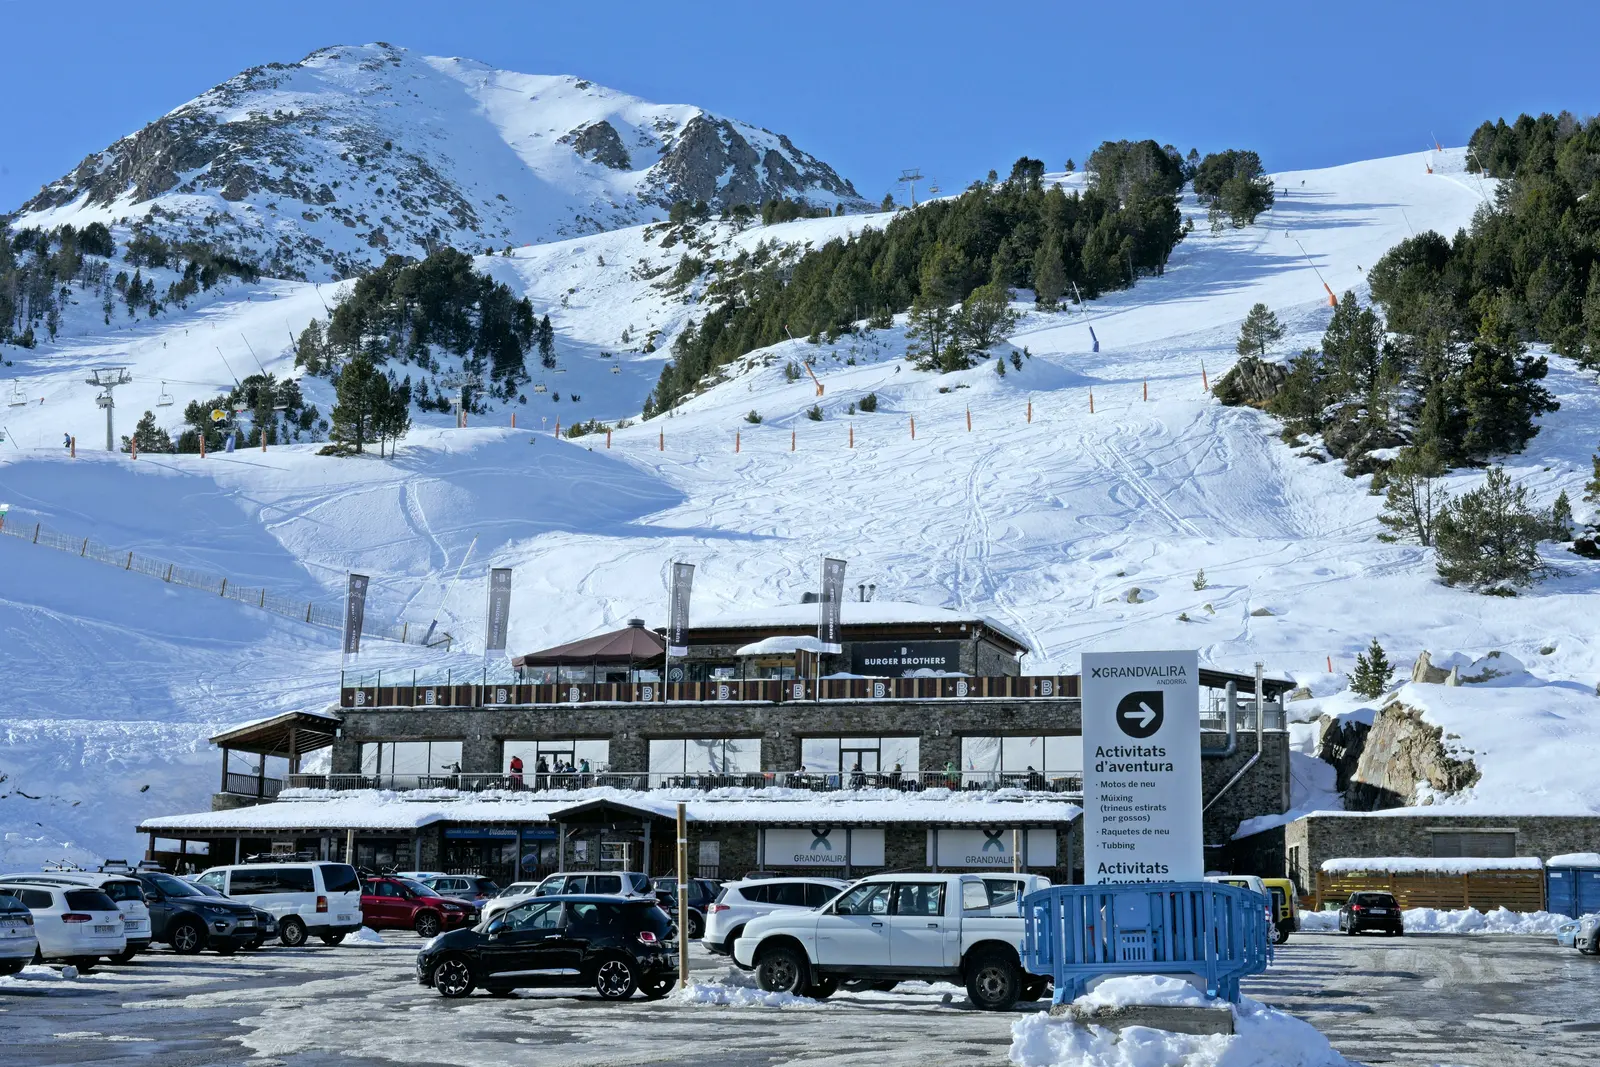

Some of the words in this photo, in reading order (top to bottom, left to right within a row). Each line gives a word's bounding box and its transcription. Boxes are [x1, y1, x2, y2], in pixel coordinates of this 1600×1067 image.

[901, 657, 946, 665] BROTHERS
[1095, 745, 1166, 758] Activitats
[1095, 761, 1173, 772] d'aventura
[1100, 794, 1133, 803] Múixing
[1100, 804, 1133, 813] (trineus
[1103, 815, 1116, 823] per
[1118, 814, 1151, 823] gossos)
[1102, 828, 1140, 836] Raquetes
[1102, 842, 1135, 850] Tubbing
[1097, 862, 1169, 874] Activitats
